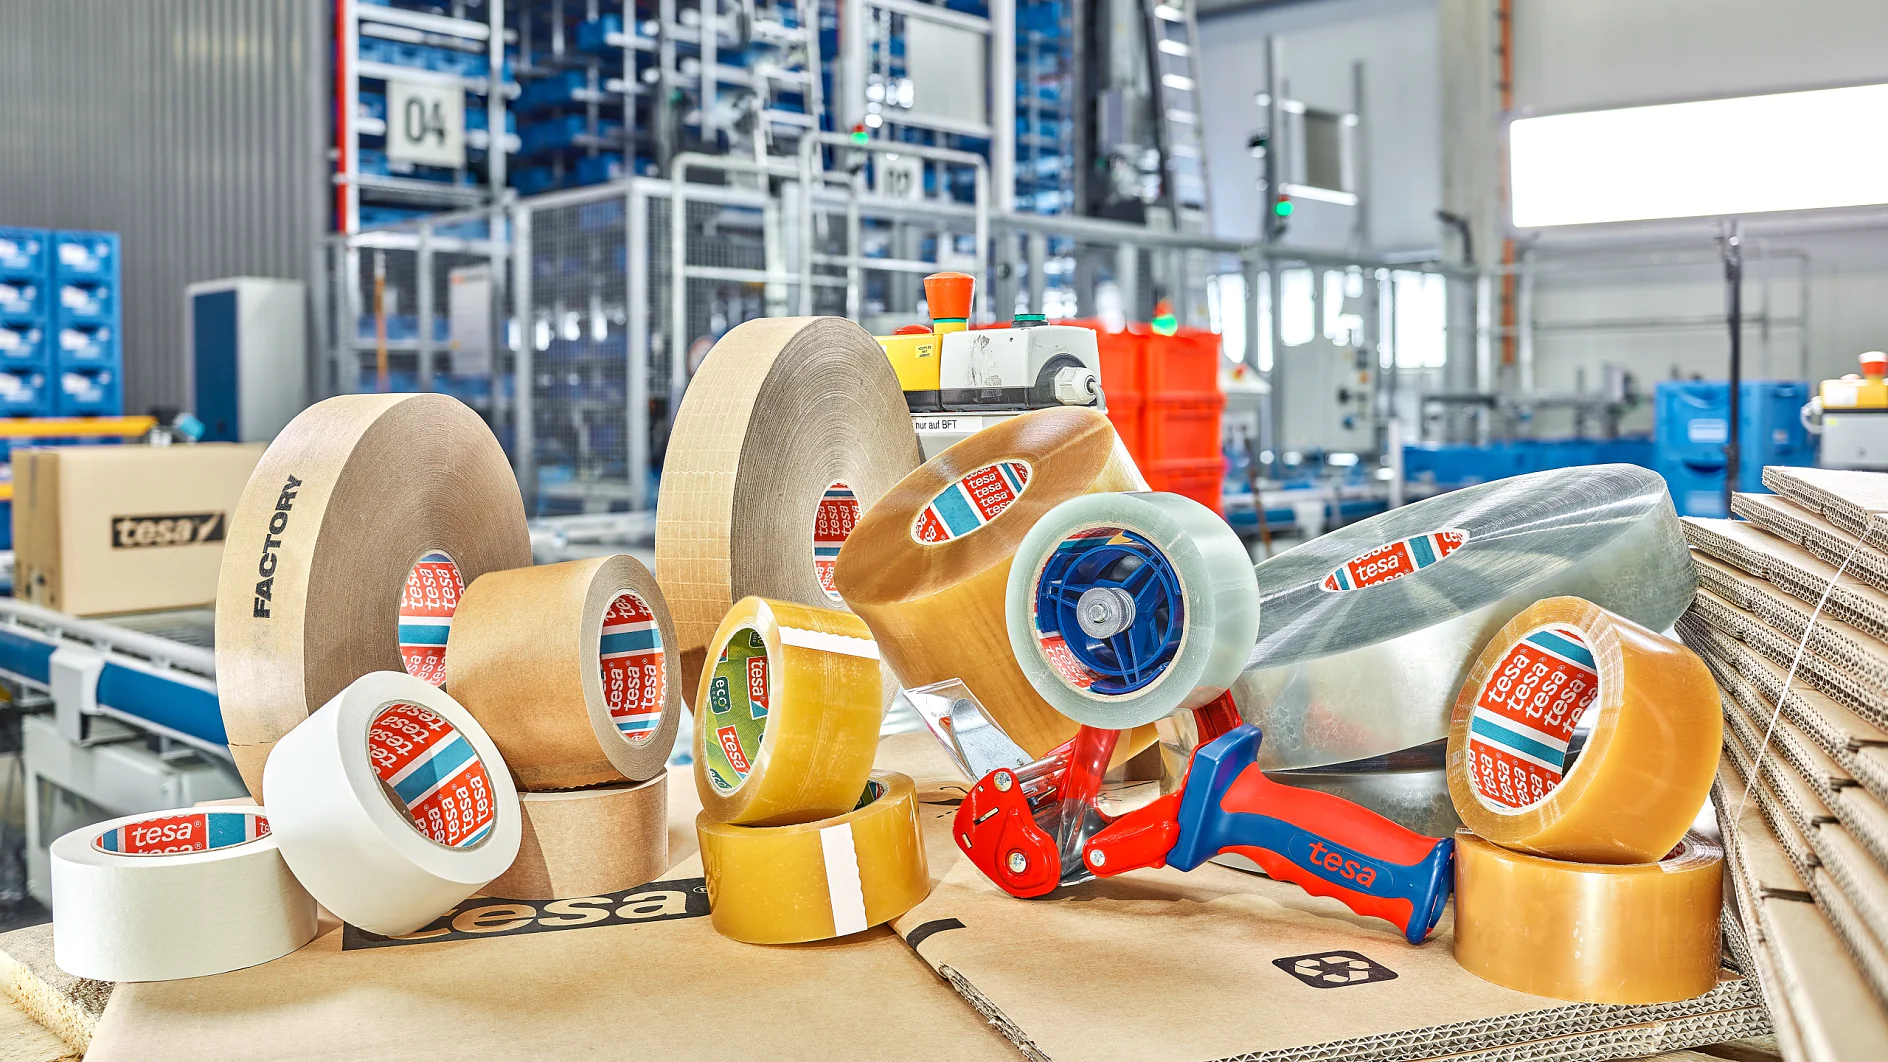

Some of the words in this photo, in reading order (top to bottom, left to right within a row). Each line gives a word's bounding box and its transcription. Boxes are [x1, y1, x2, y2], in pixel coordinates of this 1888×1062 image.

[405, 97, 446, 146] 04
[915, 421, 927, 430] nur
[928, 419, 940, 430] auf
[941, 419, 957, 430] BFT
[968, 473, 997, 489] tesa
[974, 482, 1003, 499] tesa
[980, 491, 1008, 508] tesa
[117, 516, 193, 546] tesa
[253, 474, 302, 618] FACTORY
[419, 568, 440, 610] tesa
[436, 568, 457, 610] tesa
[624, 666, 640, 712] tesa
[640, 664, 657, 710] tesa
[751, 659, 765, 696] tesa
[1488, 654, 1531, 703] tesa
[1506, 662, 1550, 711] tesa
[1525, 670, 1568, 719] tesa
[1543, 678, 1587, 727] tesa
[380, 716, 430, 744] tesa
[722, 731, 746, 768] tesa
[1480, 753, 1500, 797] tesa
[1496, 760, 1517, 804] tesa
[441, 796, 460, 845] tesa
[455, 786, 475, 835] tesa
[470, 775, 489, 824] tesa
[1308, 841, 1377, 889] tesa
